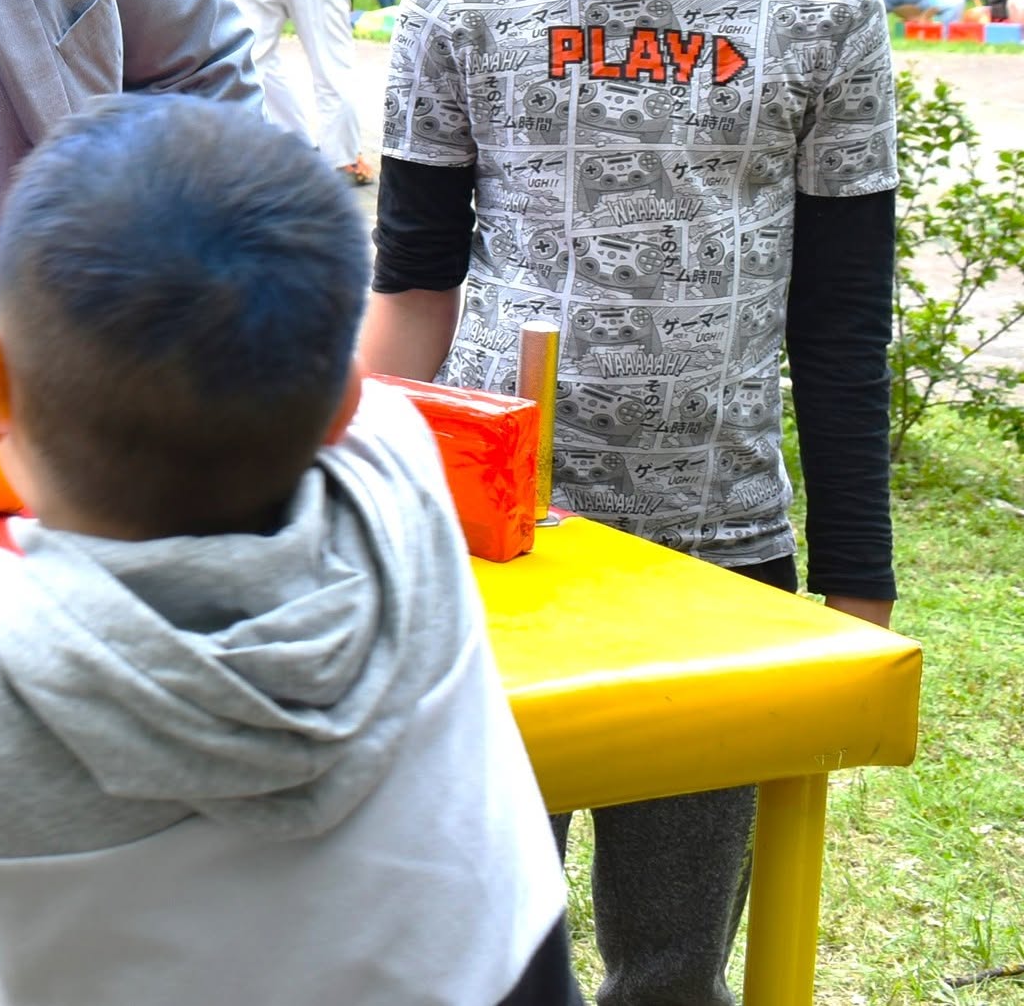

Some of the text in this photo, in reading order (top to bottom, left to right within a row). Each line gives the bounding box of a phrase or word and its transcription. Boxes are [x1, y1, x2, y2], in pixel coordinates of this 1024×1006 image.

[718, 24, 752, 35] UGH!!
[548, 25, 705, 85] PLAY
[528, 178, 560, 188] UGH!!
[696, 331, 724, 342] UGH!!
[668, 476, 700, 486] UGH!!
